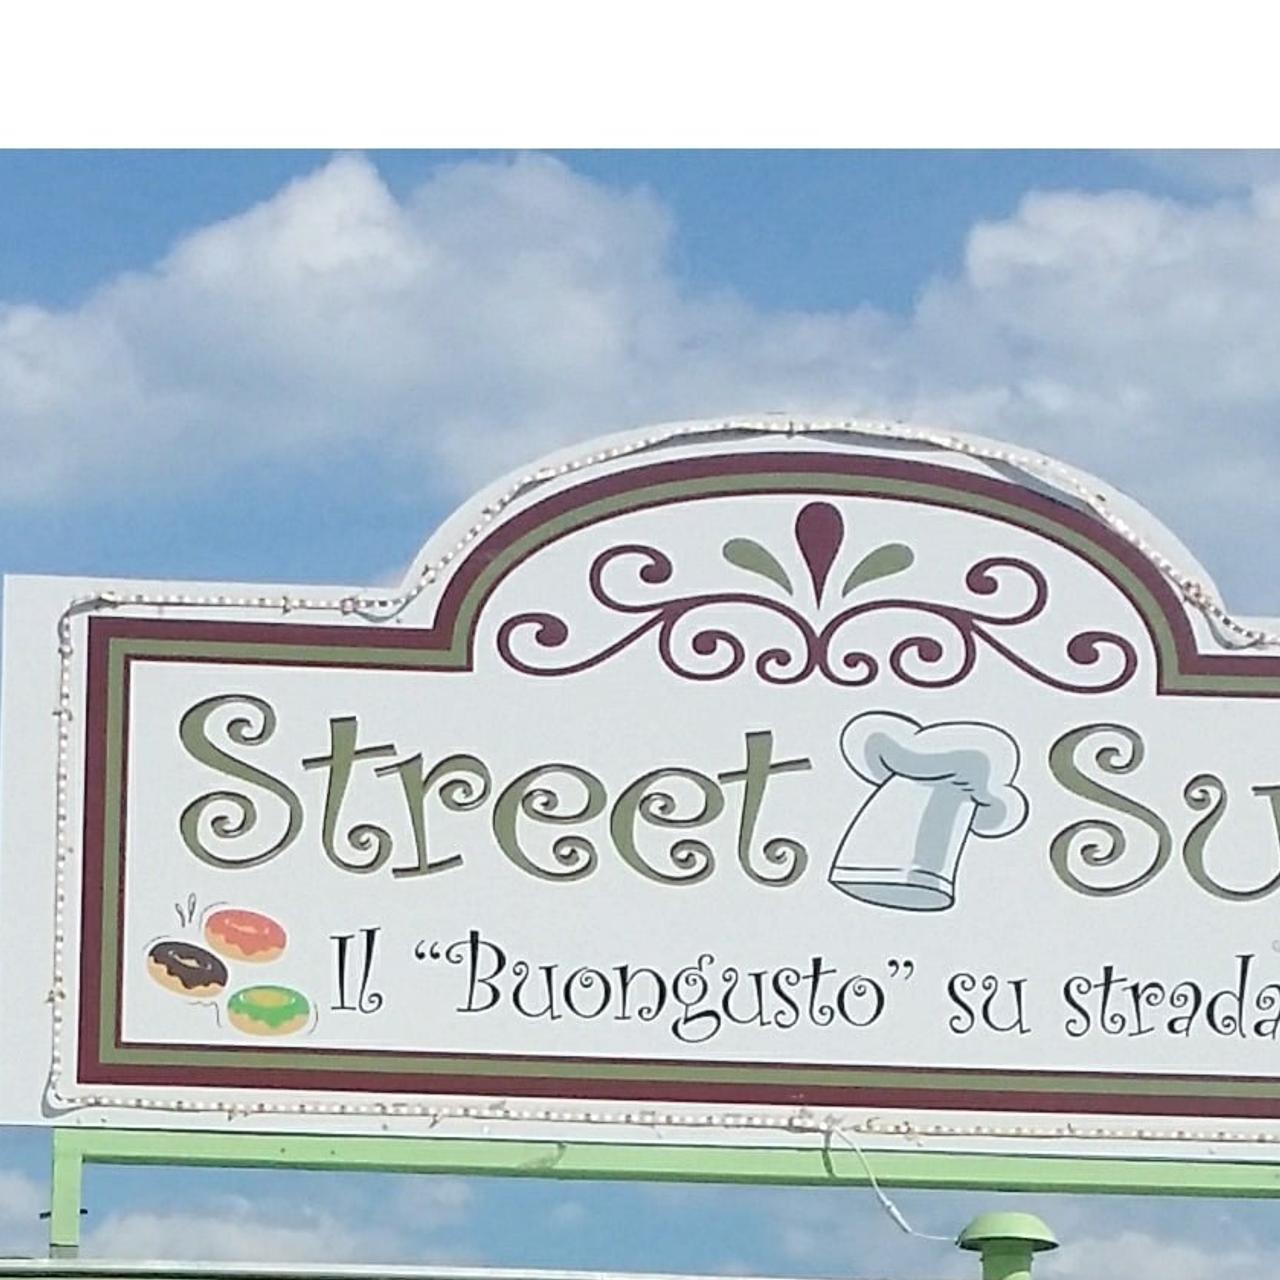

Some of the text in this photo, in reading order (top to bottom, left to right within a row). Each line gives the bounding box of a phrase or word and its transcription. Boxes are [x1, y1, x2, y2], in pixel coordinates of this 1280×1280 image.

[179, 693, 813, 886] Street
[330, 927, 384, 1014] Il
[947, 971, 1032, 1036] su
